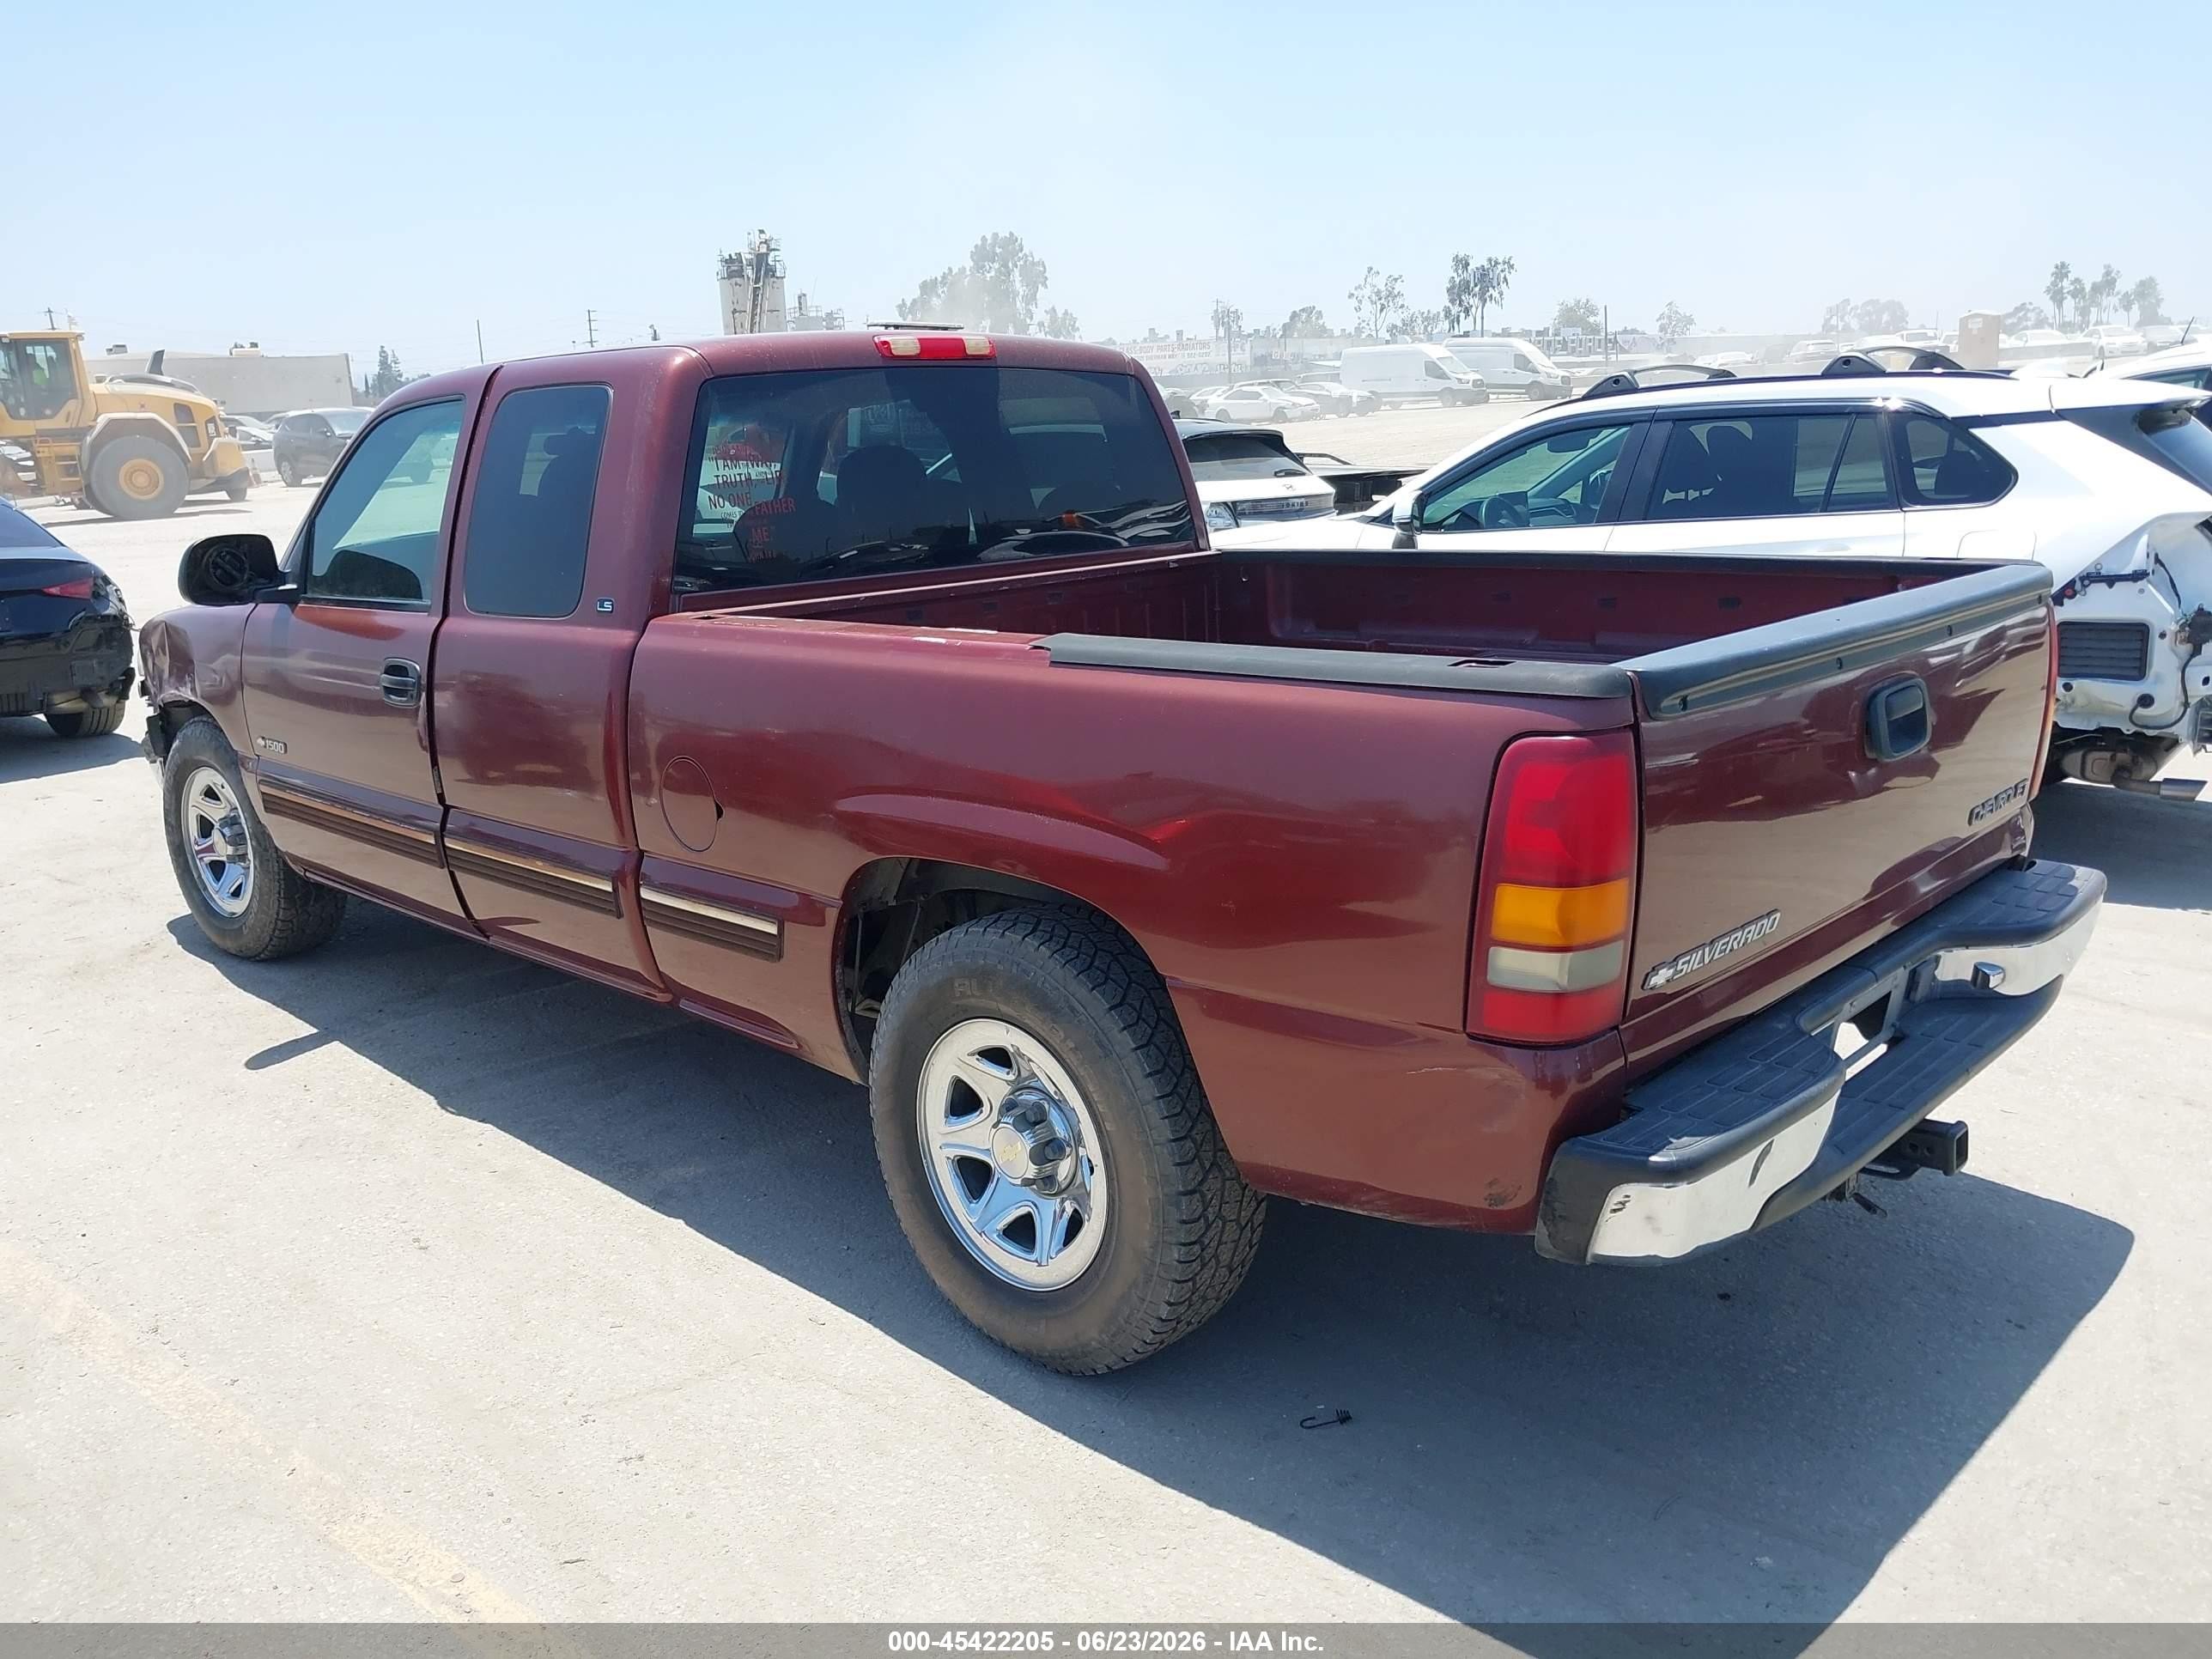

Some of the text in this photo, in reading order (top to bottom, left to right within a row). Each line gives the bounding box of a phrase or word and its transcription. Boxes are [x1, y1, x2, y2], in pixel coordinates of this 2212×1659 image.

[722, 457, 741, 471] AM
[708, 491, 753, 510] NO ONE
[755, 497, 797, 516] FATHER
[597, 601, 612, 611] LS
[266, 738, 284, 754] 1500
[1673, 911, 1782, 981] SILVERADO
